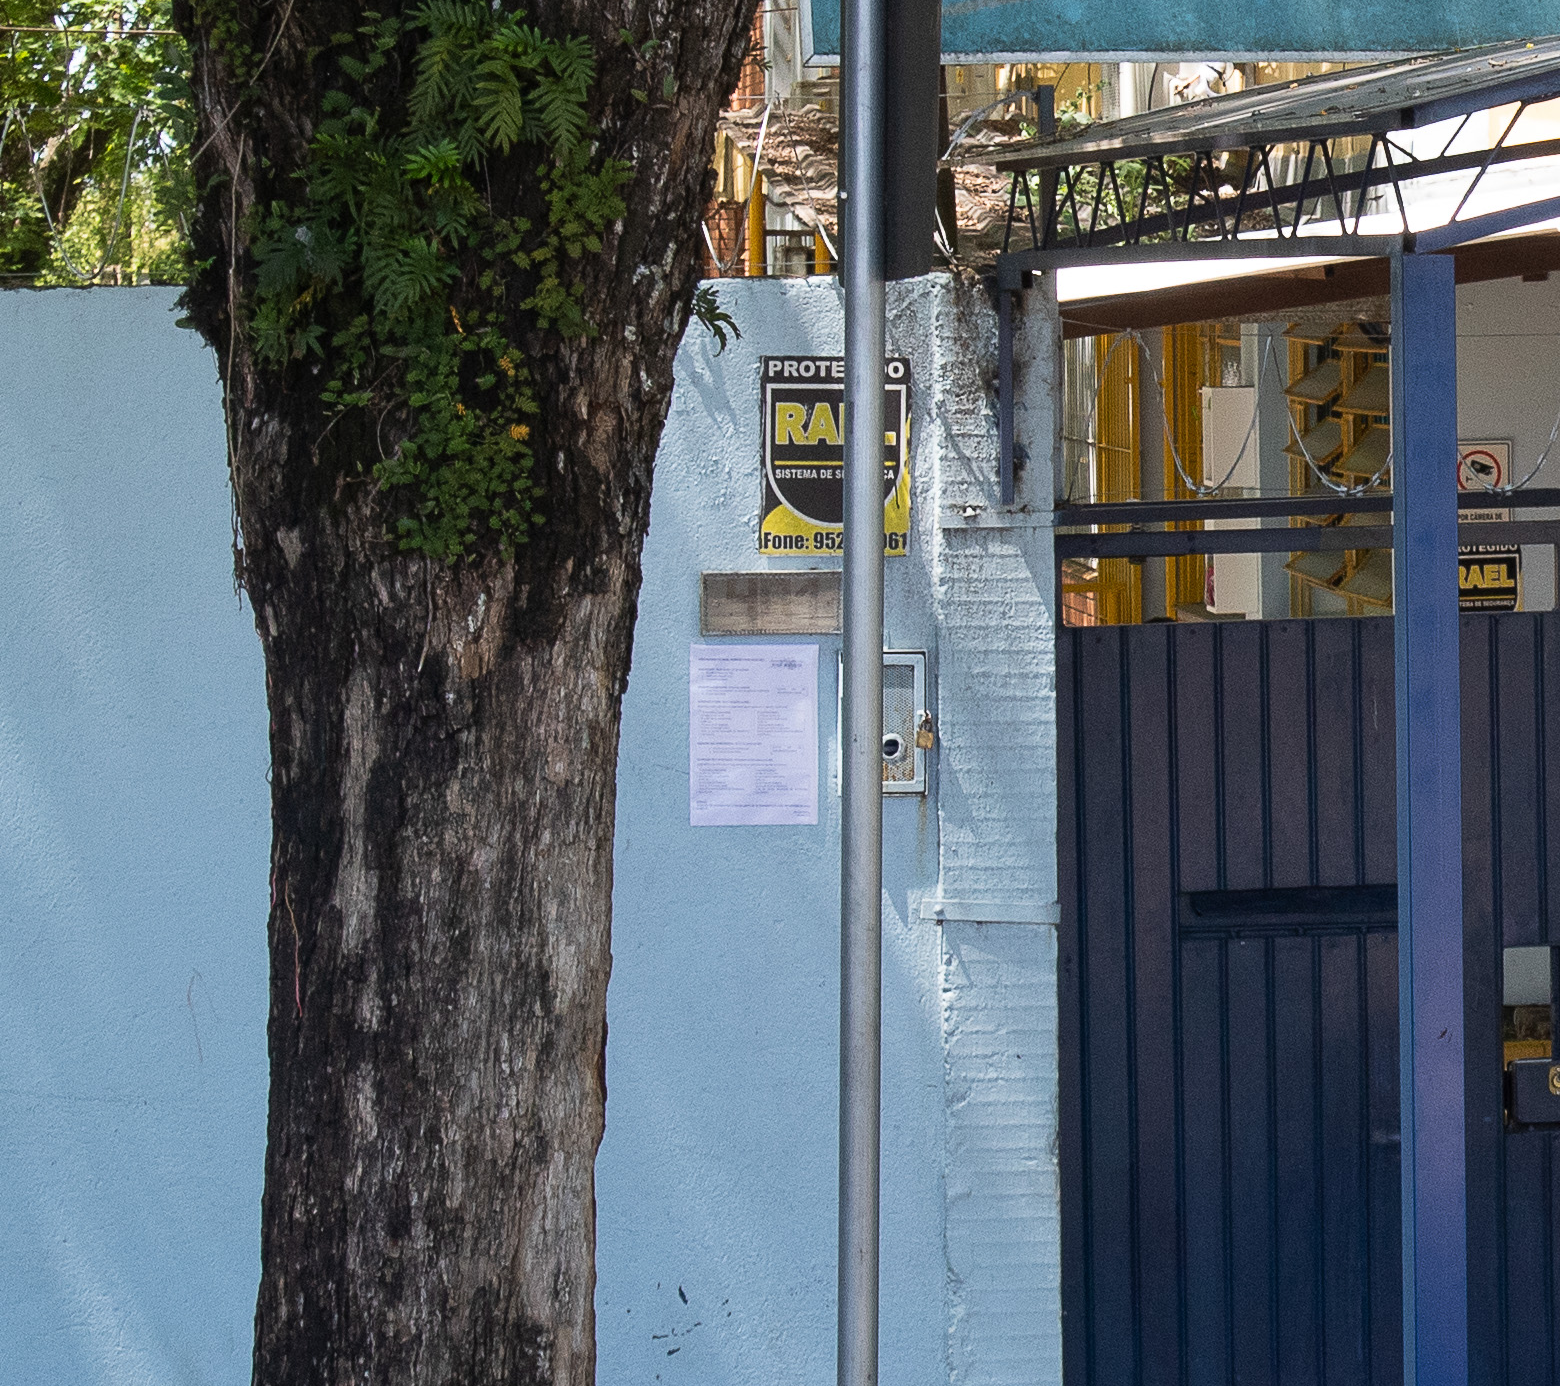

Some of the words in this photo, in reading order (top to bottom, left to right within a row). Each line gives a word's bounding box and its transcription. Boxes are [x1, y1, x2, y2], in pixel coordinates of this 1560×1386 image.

[768, 360, 905, 379] PROTEO
[775, 469, 818, 480] SISTEMA
[820, 469, 833, 479] DE
[763, 531, 810, 550] Fone:
